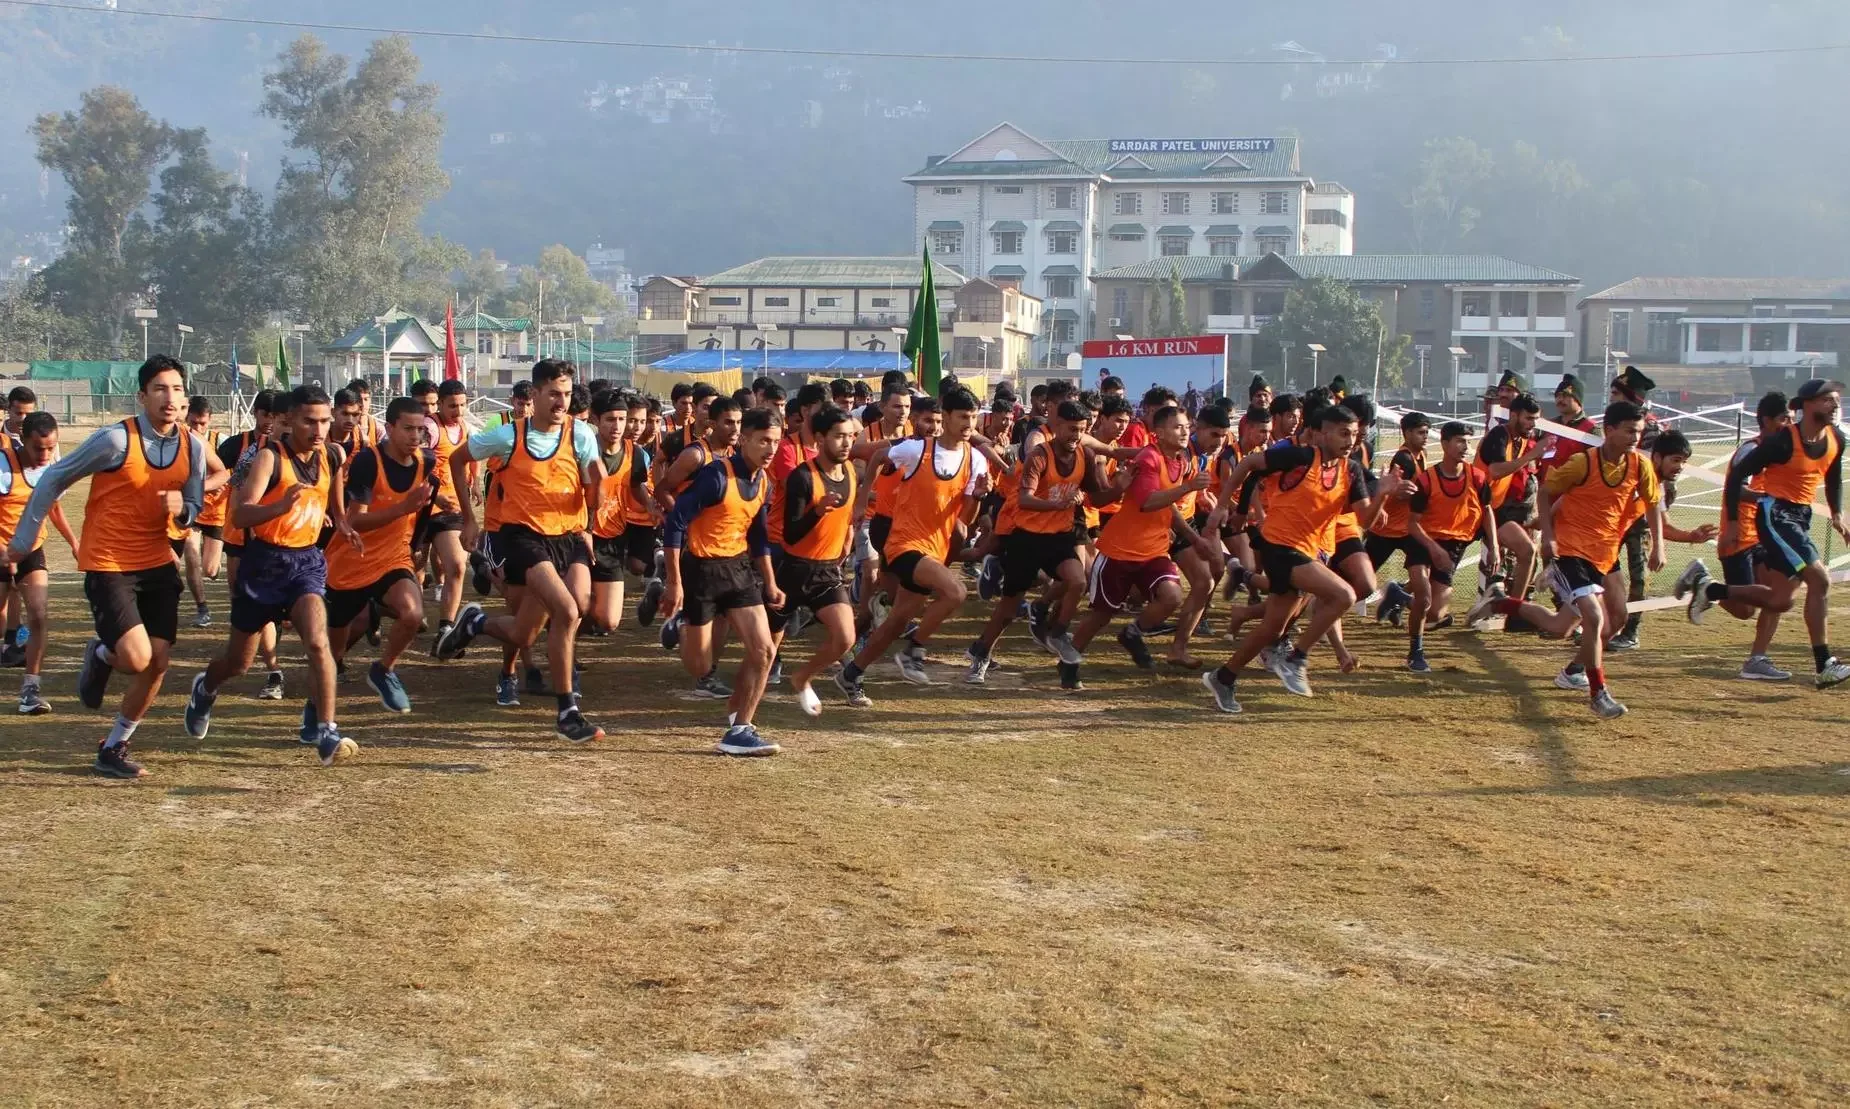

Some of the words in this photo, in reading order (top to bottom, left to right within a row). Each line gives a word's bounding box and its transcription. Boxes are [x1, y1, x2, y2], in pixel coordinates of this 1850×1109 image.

[1111, 140, 1158, 151] SARDAR
[1162, 140, 1197, 151] PATEL
[1201, 140, 1271, 151] UNIVERSITY
[1107, 343, 1128, 356] 1.6
[1133, 342, 1158, 355] KM
[1164, 340, 1199, 354] RUN
